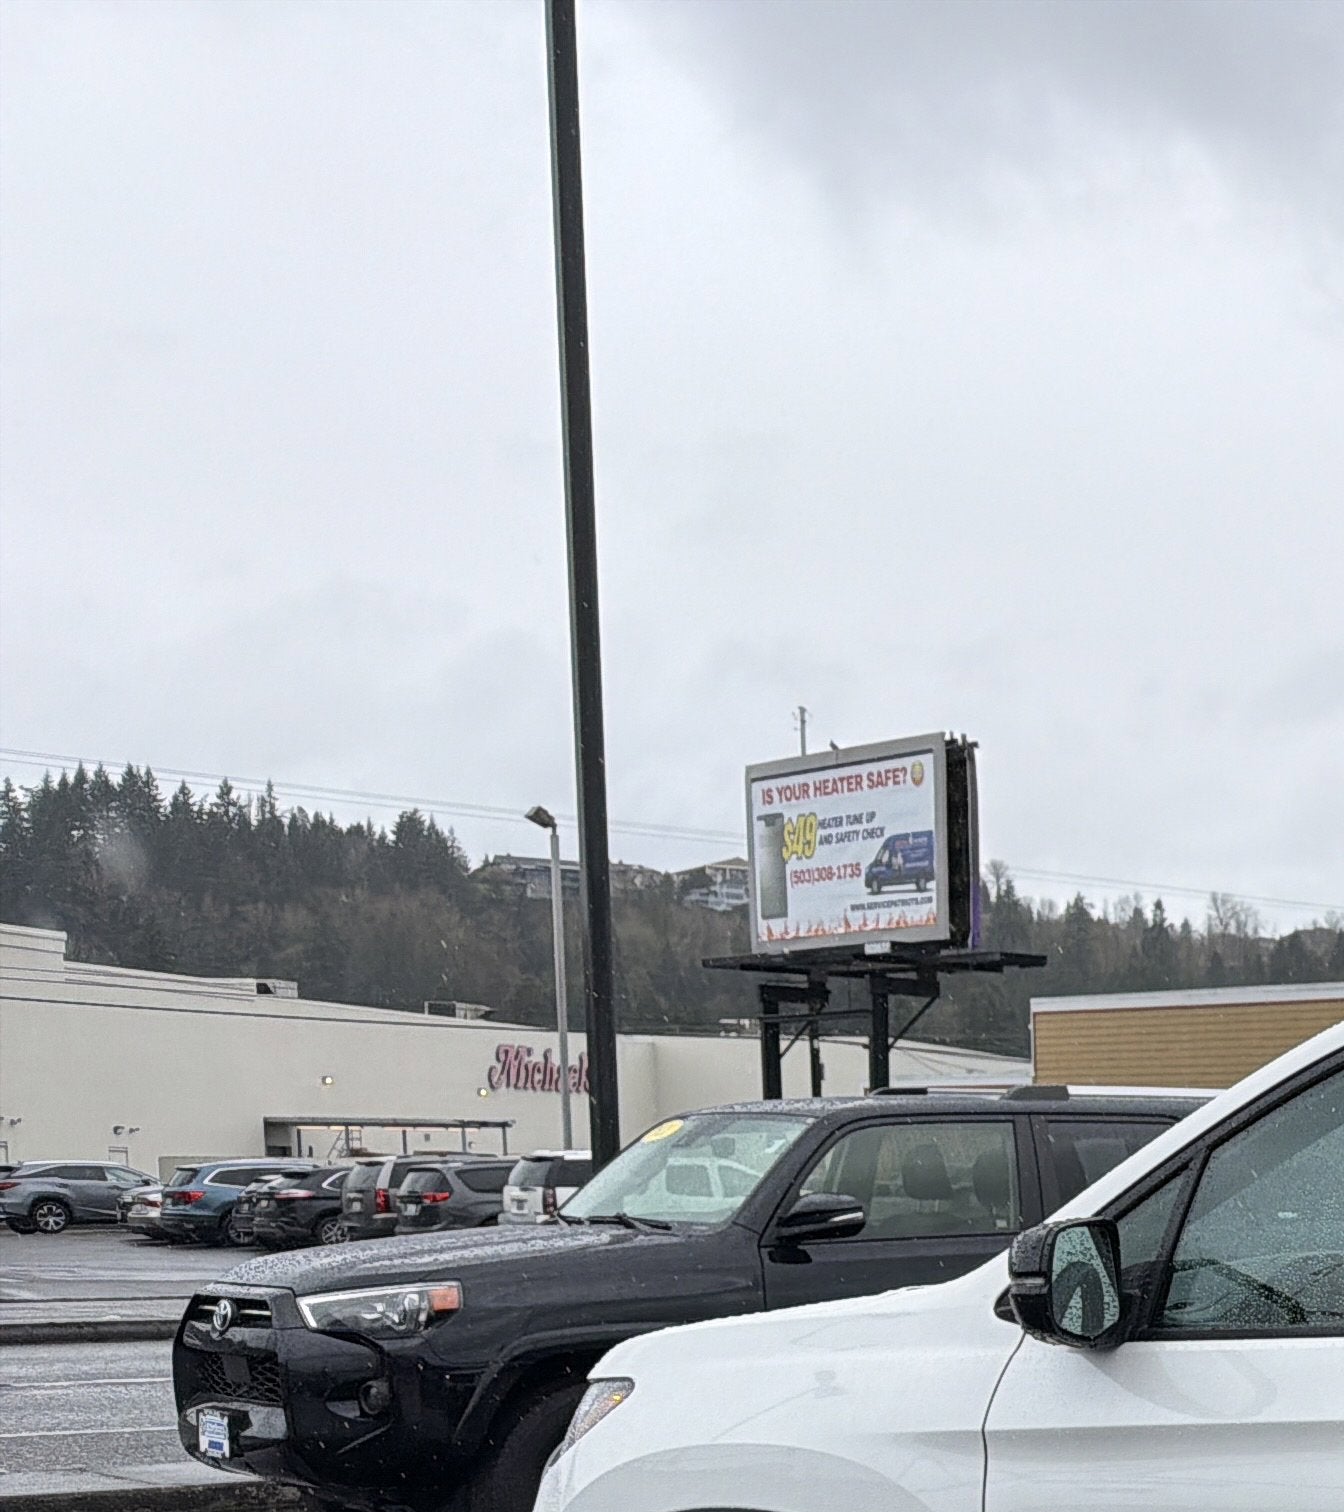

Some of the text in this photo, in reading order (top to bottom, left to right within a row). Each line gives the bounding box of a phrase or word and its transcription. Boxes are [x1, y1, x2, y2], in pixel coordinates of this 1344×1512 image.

[761, 766, 907, 805] IS YOUR HEATER SAFE?
[819, 810, 877, 830] HEATER TUNE UP
[782, 811, 818, 862] $49
[818, 826, 885, 847] AND SAFETY CHECK
